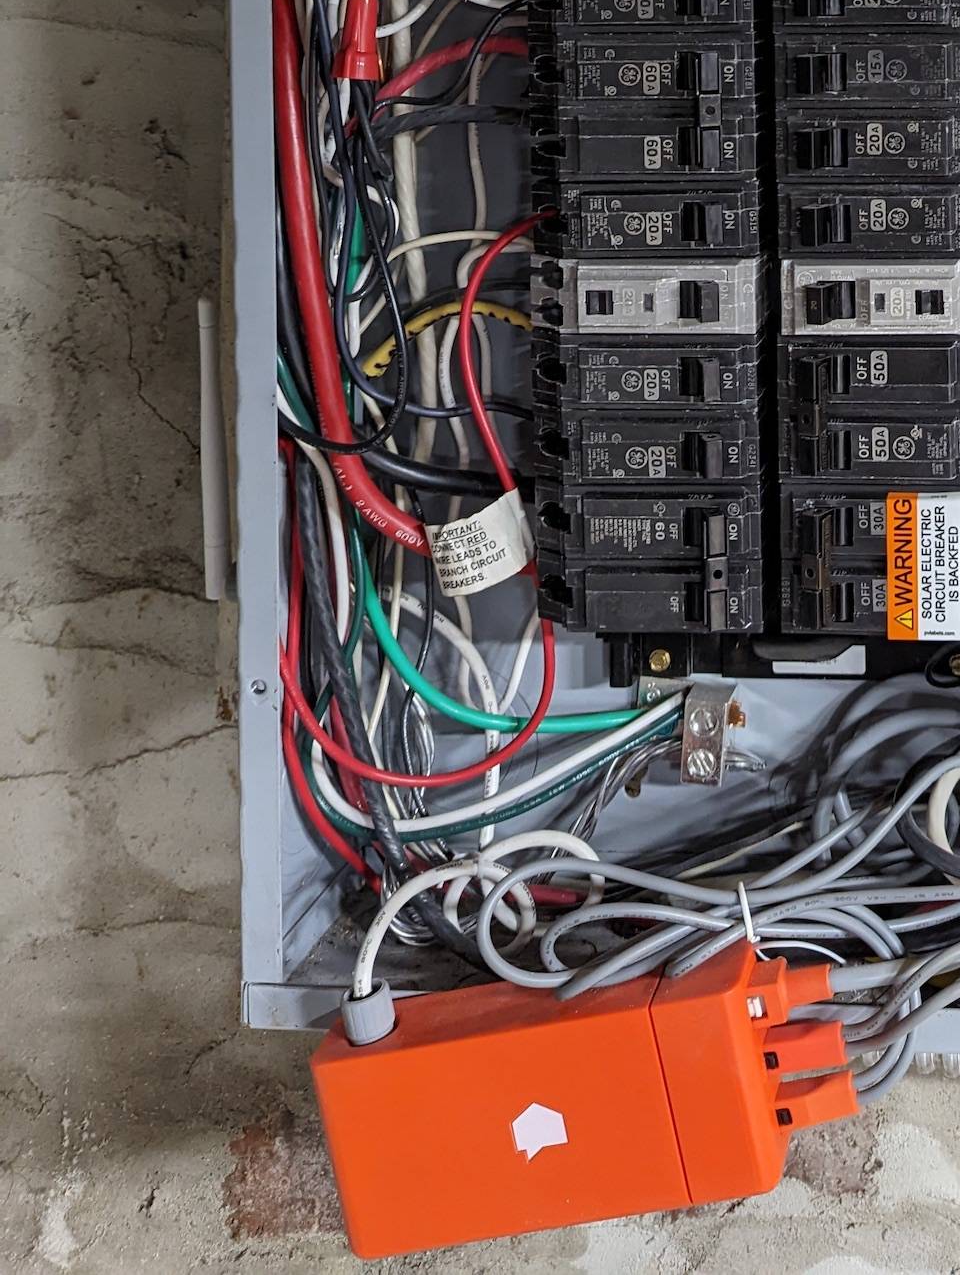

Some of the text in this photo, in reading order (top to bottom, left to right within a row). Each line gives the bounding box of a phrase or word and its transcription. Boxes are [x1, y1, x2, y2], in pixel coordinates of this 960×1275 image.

[645, 65, 656, 92] 60A
[661, 64, 671, 86] OFF
[723, 65, 734, 83] ON
[855, 60, 865, 82] OFF
[870, 53, 881, 81] 15A
[663, 138, 673, 162] OFF
[723, 141, 734, 159] ON
[855, 133, 865, 155] OFF
[869, 126, 881, 153] 20A
[647, 139, 657, 166] 60A
[663, 213, 673, 234] OFF
[725, 213, 735, 230] ON
[859, 208, 869, 231] OFF
[873, 201, 884, 228] 20A
[649, 214, 660, 243] 20A
[892, 289, 902, 315] 20A
[661, 369, 671, 391] OFF
[857, 356, 867, 380] OFF
[873, 354, 886, 382] 50A
[646, 371, 656, 398] 20A
[723, 372, 733, 390] ON
[728, 447, 739, 464] ON
[859, 435, 869, 458] OFF
[875, 430, 886, 457] 50A
[651, 449, 663, 476] 20A
[666, 446, 677, 468] OFF
[859, 504, 868, 529] OFF
[873, 507, 884, 530] 30A
[395, 529, 425, 547] 600V
[432, 531, 487, 553] CONNECT RED
[655, 522, 665, 540] 60
[669, 523, 679, 540] OFF
[729, 523, 738, 541] ON
[934, 506, 945, 567] BREAKER
[435, 540, 496, 565] WIRE LEADS TO
[439, 548, 506, 578] BRANCH CIRCUIT
[894, 499, 913, 607] WARNING
[921, 509, 932, 619] SOLAR ELECTRIC
[948, 526, 959, 602] IS BACKFED
[670, 597, 680, 613] OFF
[729, 597, 739, 614] ON
[861, 582, 870, 606] OFF
[875, 584, 886, 608] 30A
[935, 572, 946, 622] CIRCUIT
